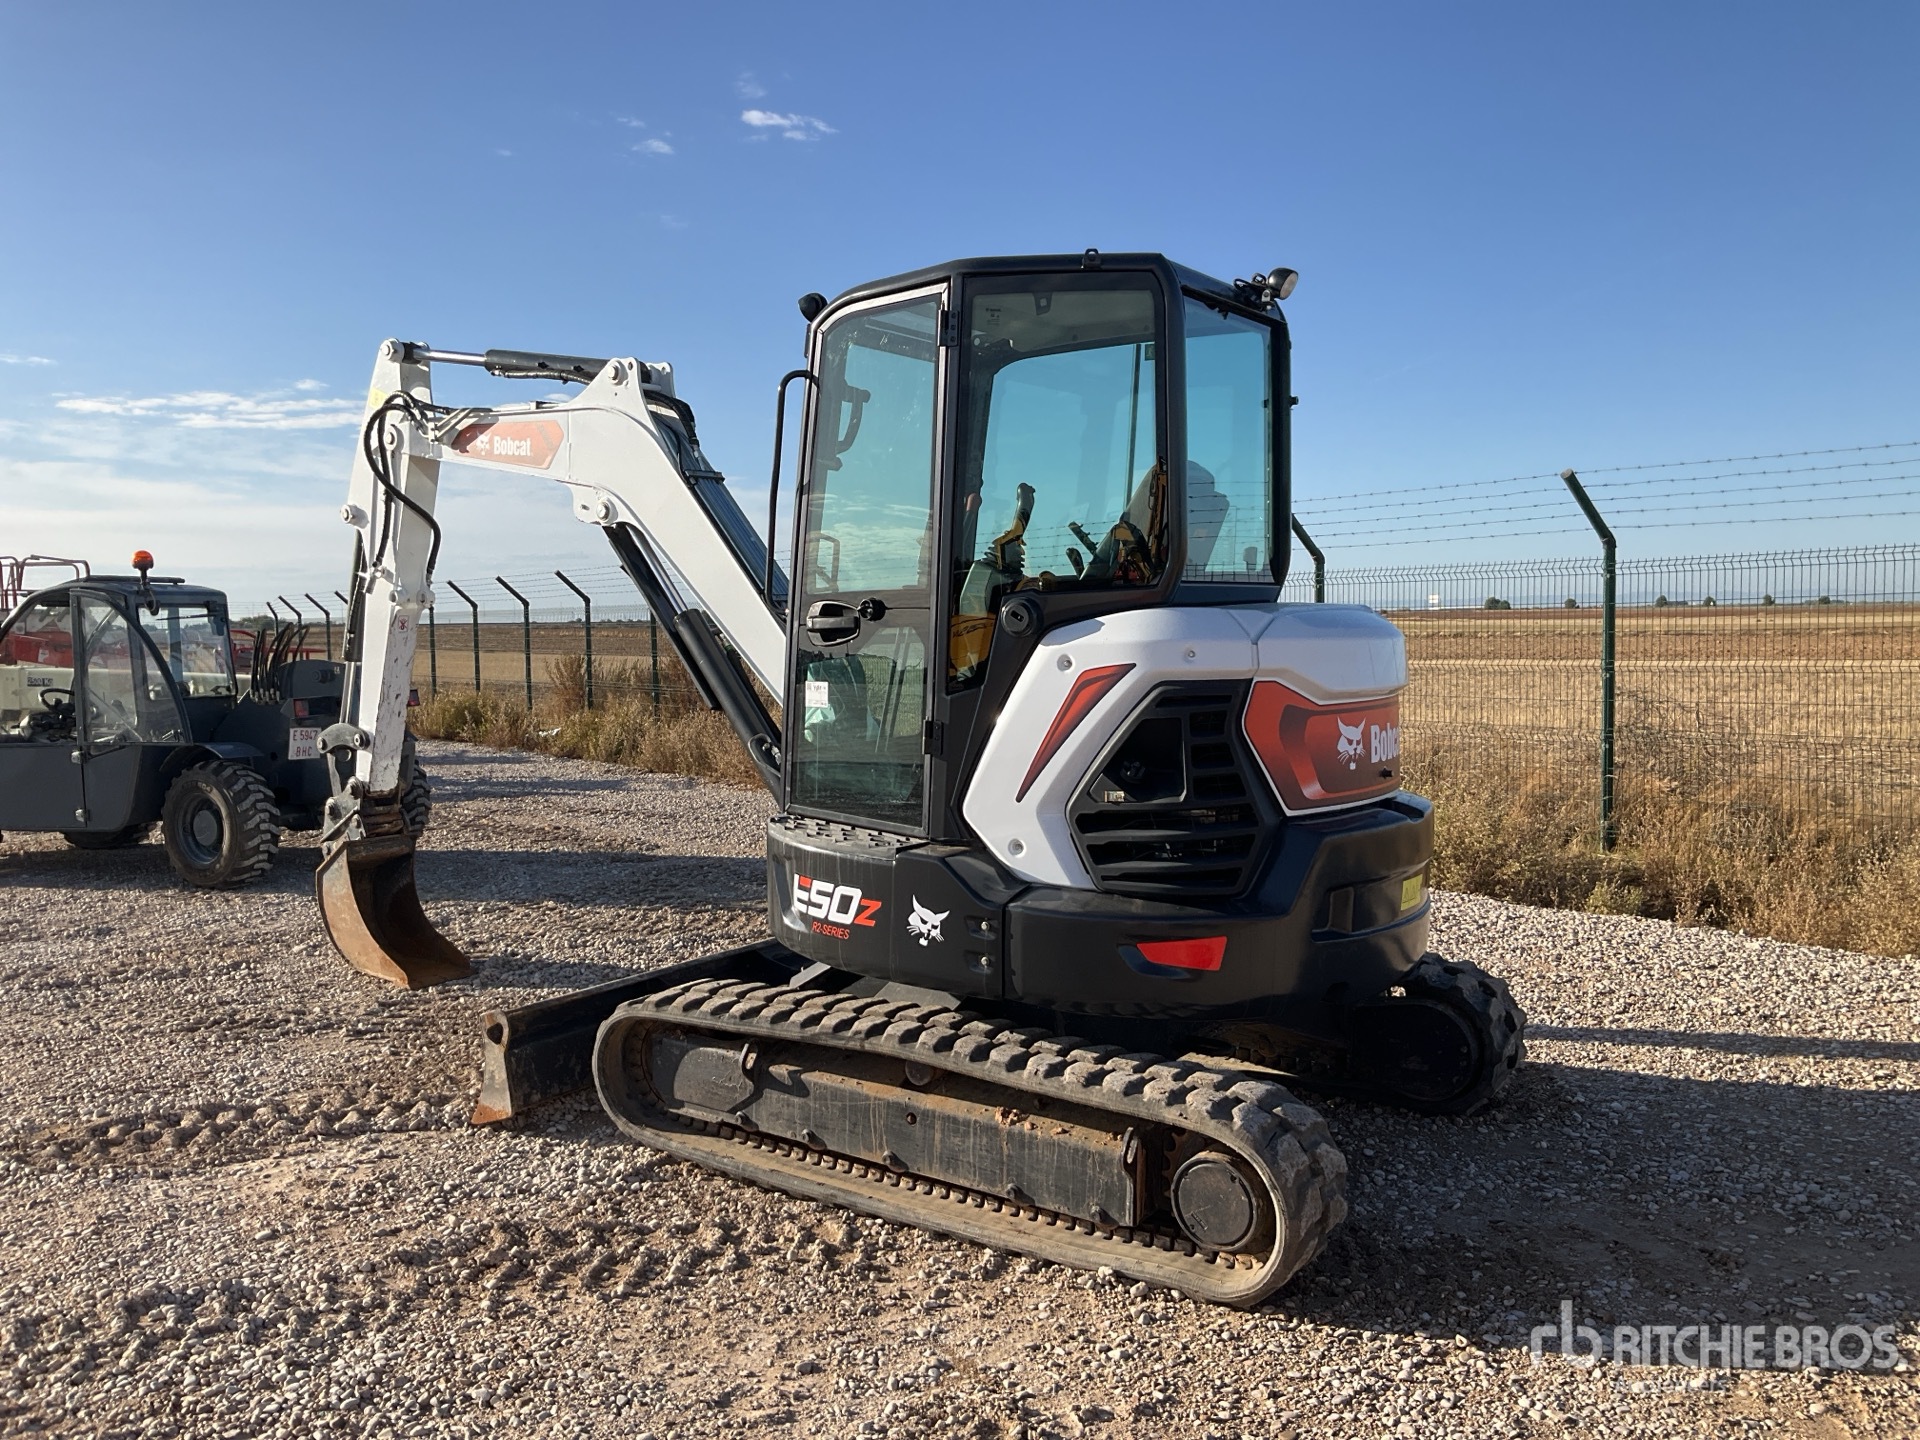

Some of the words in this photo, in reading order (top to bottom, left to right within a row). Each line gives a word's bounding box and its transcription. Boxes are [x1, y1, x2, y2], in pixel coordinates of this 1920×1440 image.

[493, 435, 532, 456] Bobcat
[292, 730, 298, 741] E
[1370, 722, 1400, 763] Bobc
[812, 921, 850, 939] R2-SERIES
